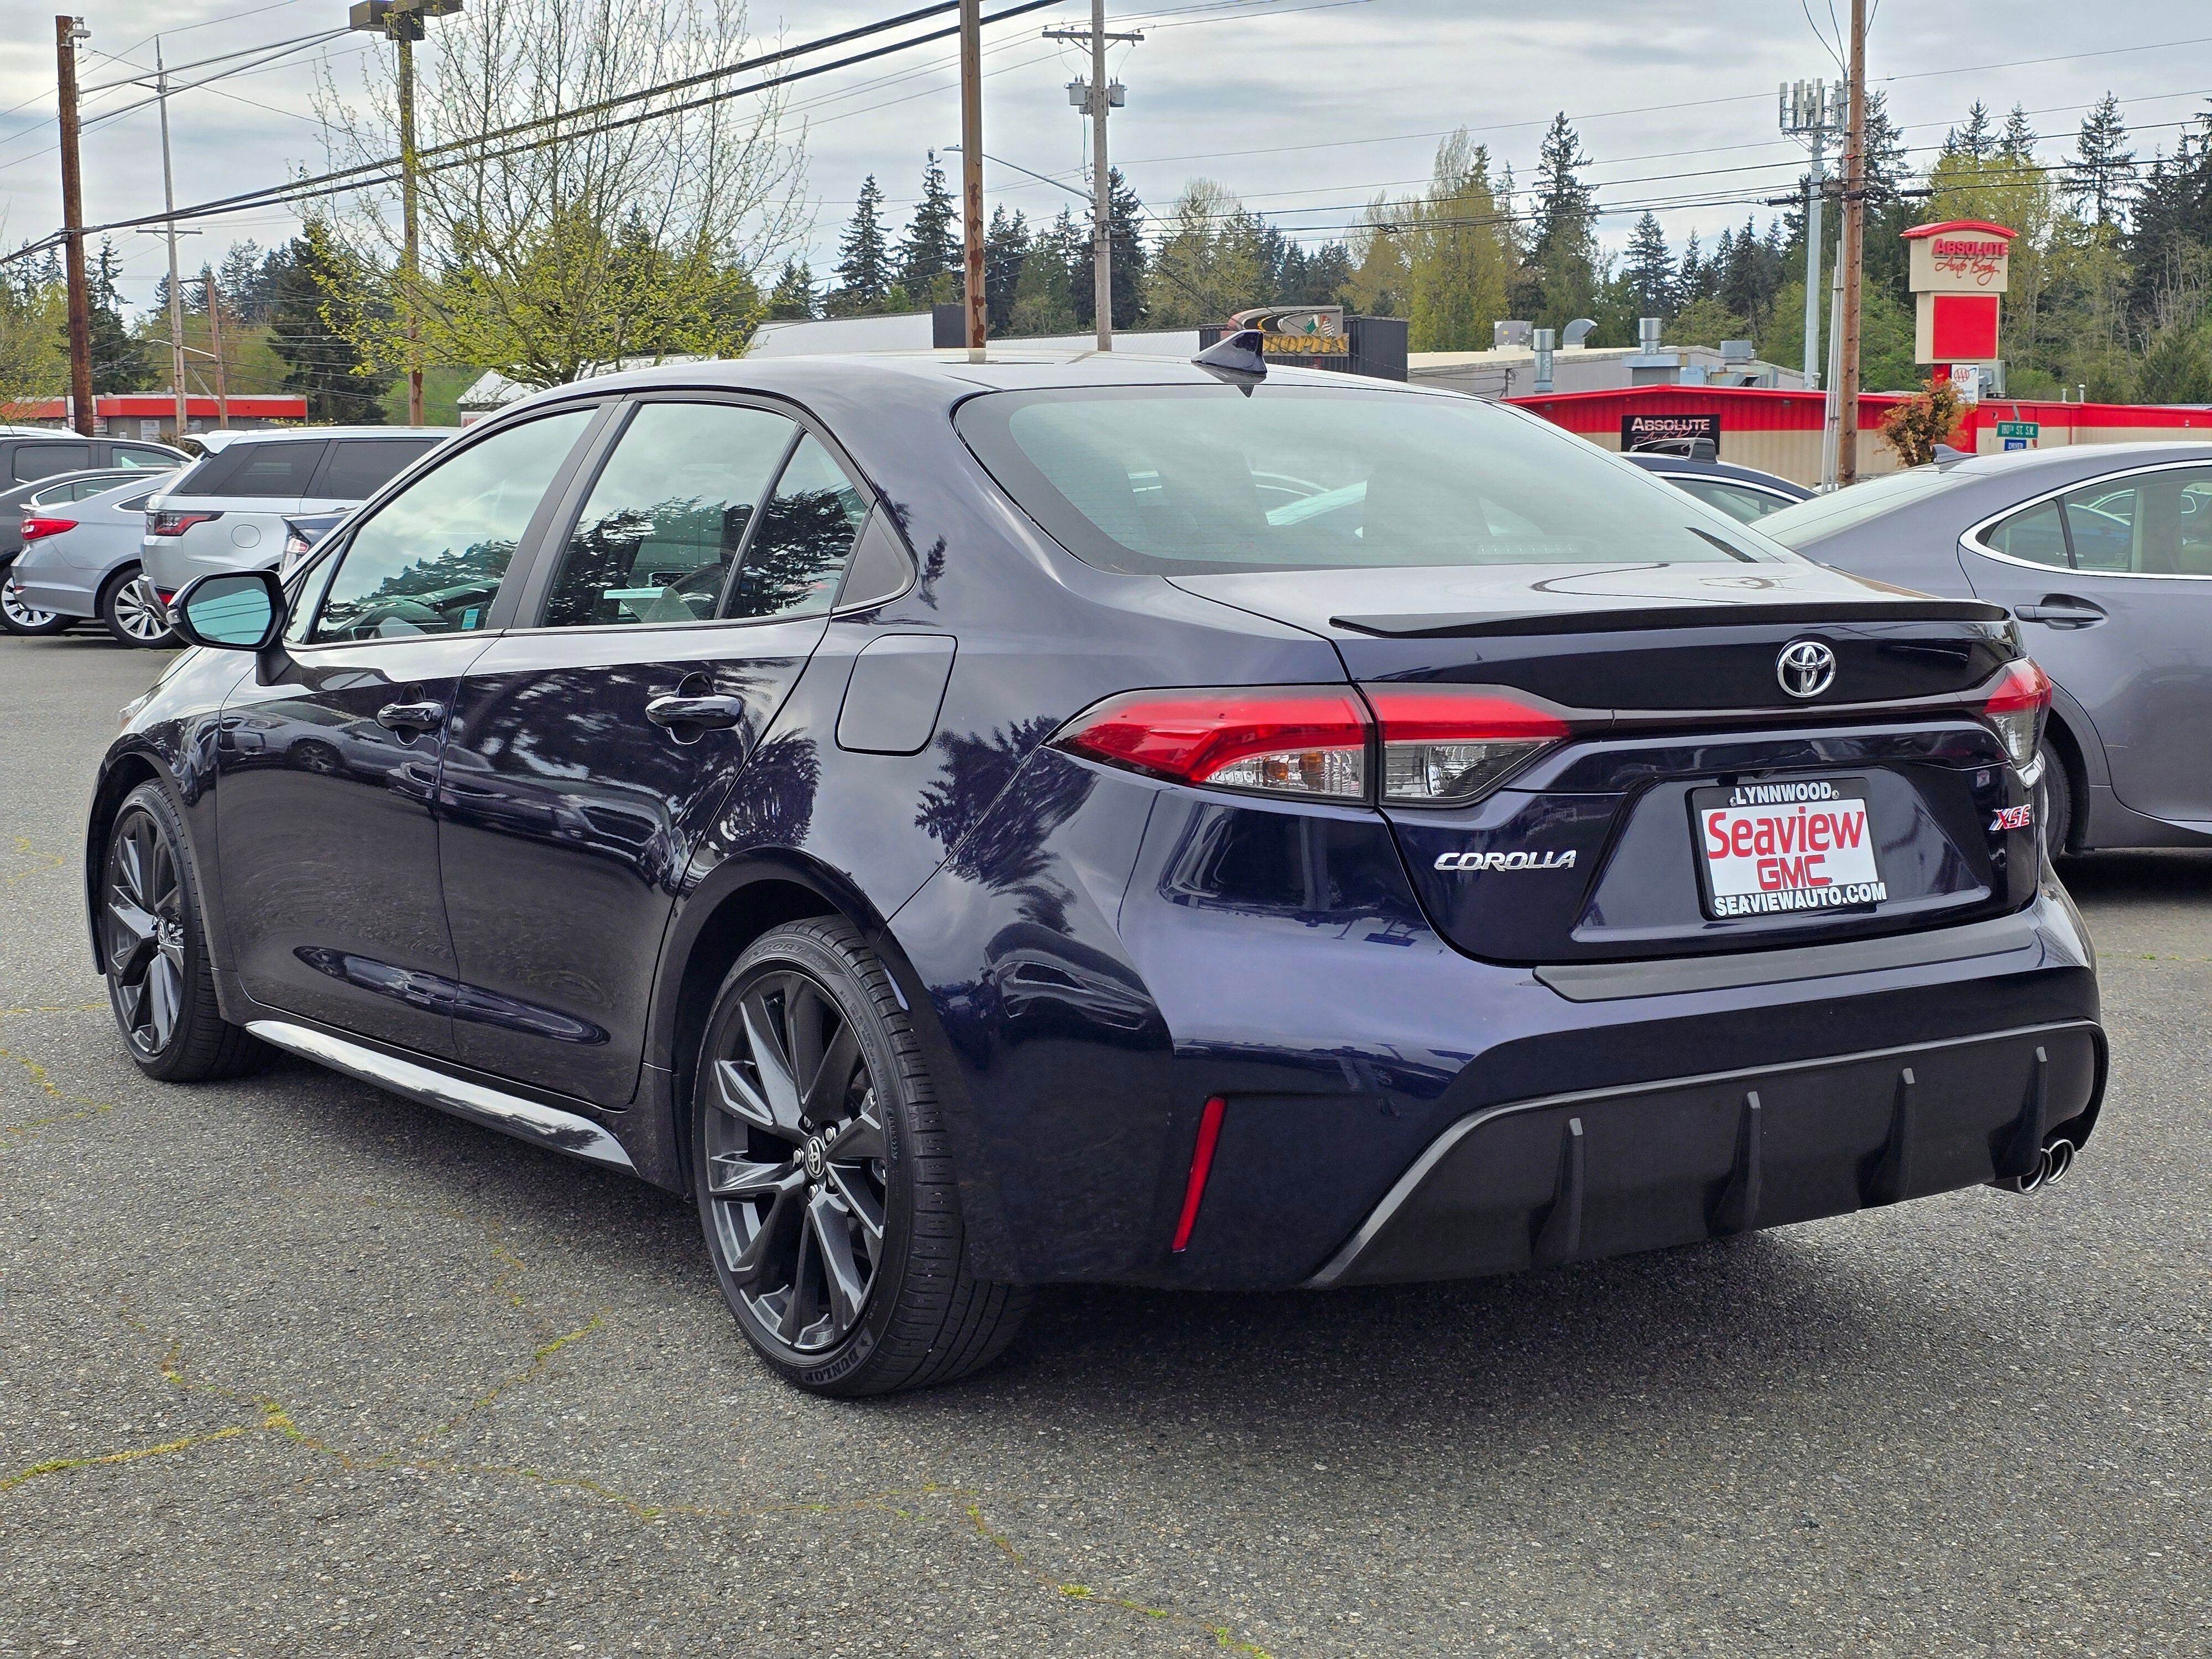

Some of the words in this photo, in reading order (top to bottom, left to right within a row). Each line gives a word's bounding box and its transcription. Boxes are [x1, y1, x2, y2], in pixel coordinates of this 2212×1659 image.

[1932, 238, 2008, 255] ABSOLUTE
[1936, 256, 1969, 278] Auto
[1969, 255, 2000, 286] Body
[1631, 417, 1710, 431] ABSOLUTE
[1735, 782, 1832, 805] LYNNWOOD
[1990, 804, 2031, 830] XSE
[1708, 806, 1865, 859] Seaview
[1434, 850, 1576, 872] COROLLA
[1757, 854, 1832, 891] GMC
[1714, 882, 1887, 917] SEAVIEWAUTO.COM
[752, 942, 806, 957] SPORT
[805, 1347, 859, 1381] DUNLOP
